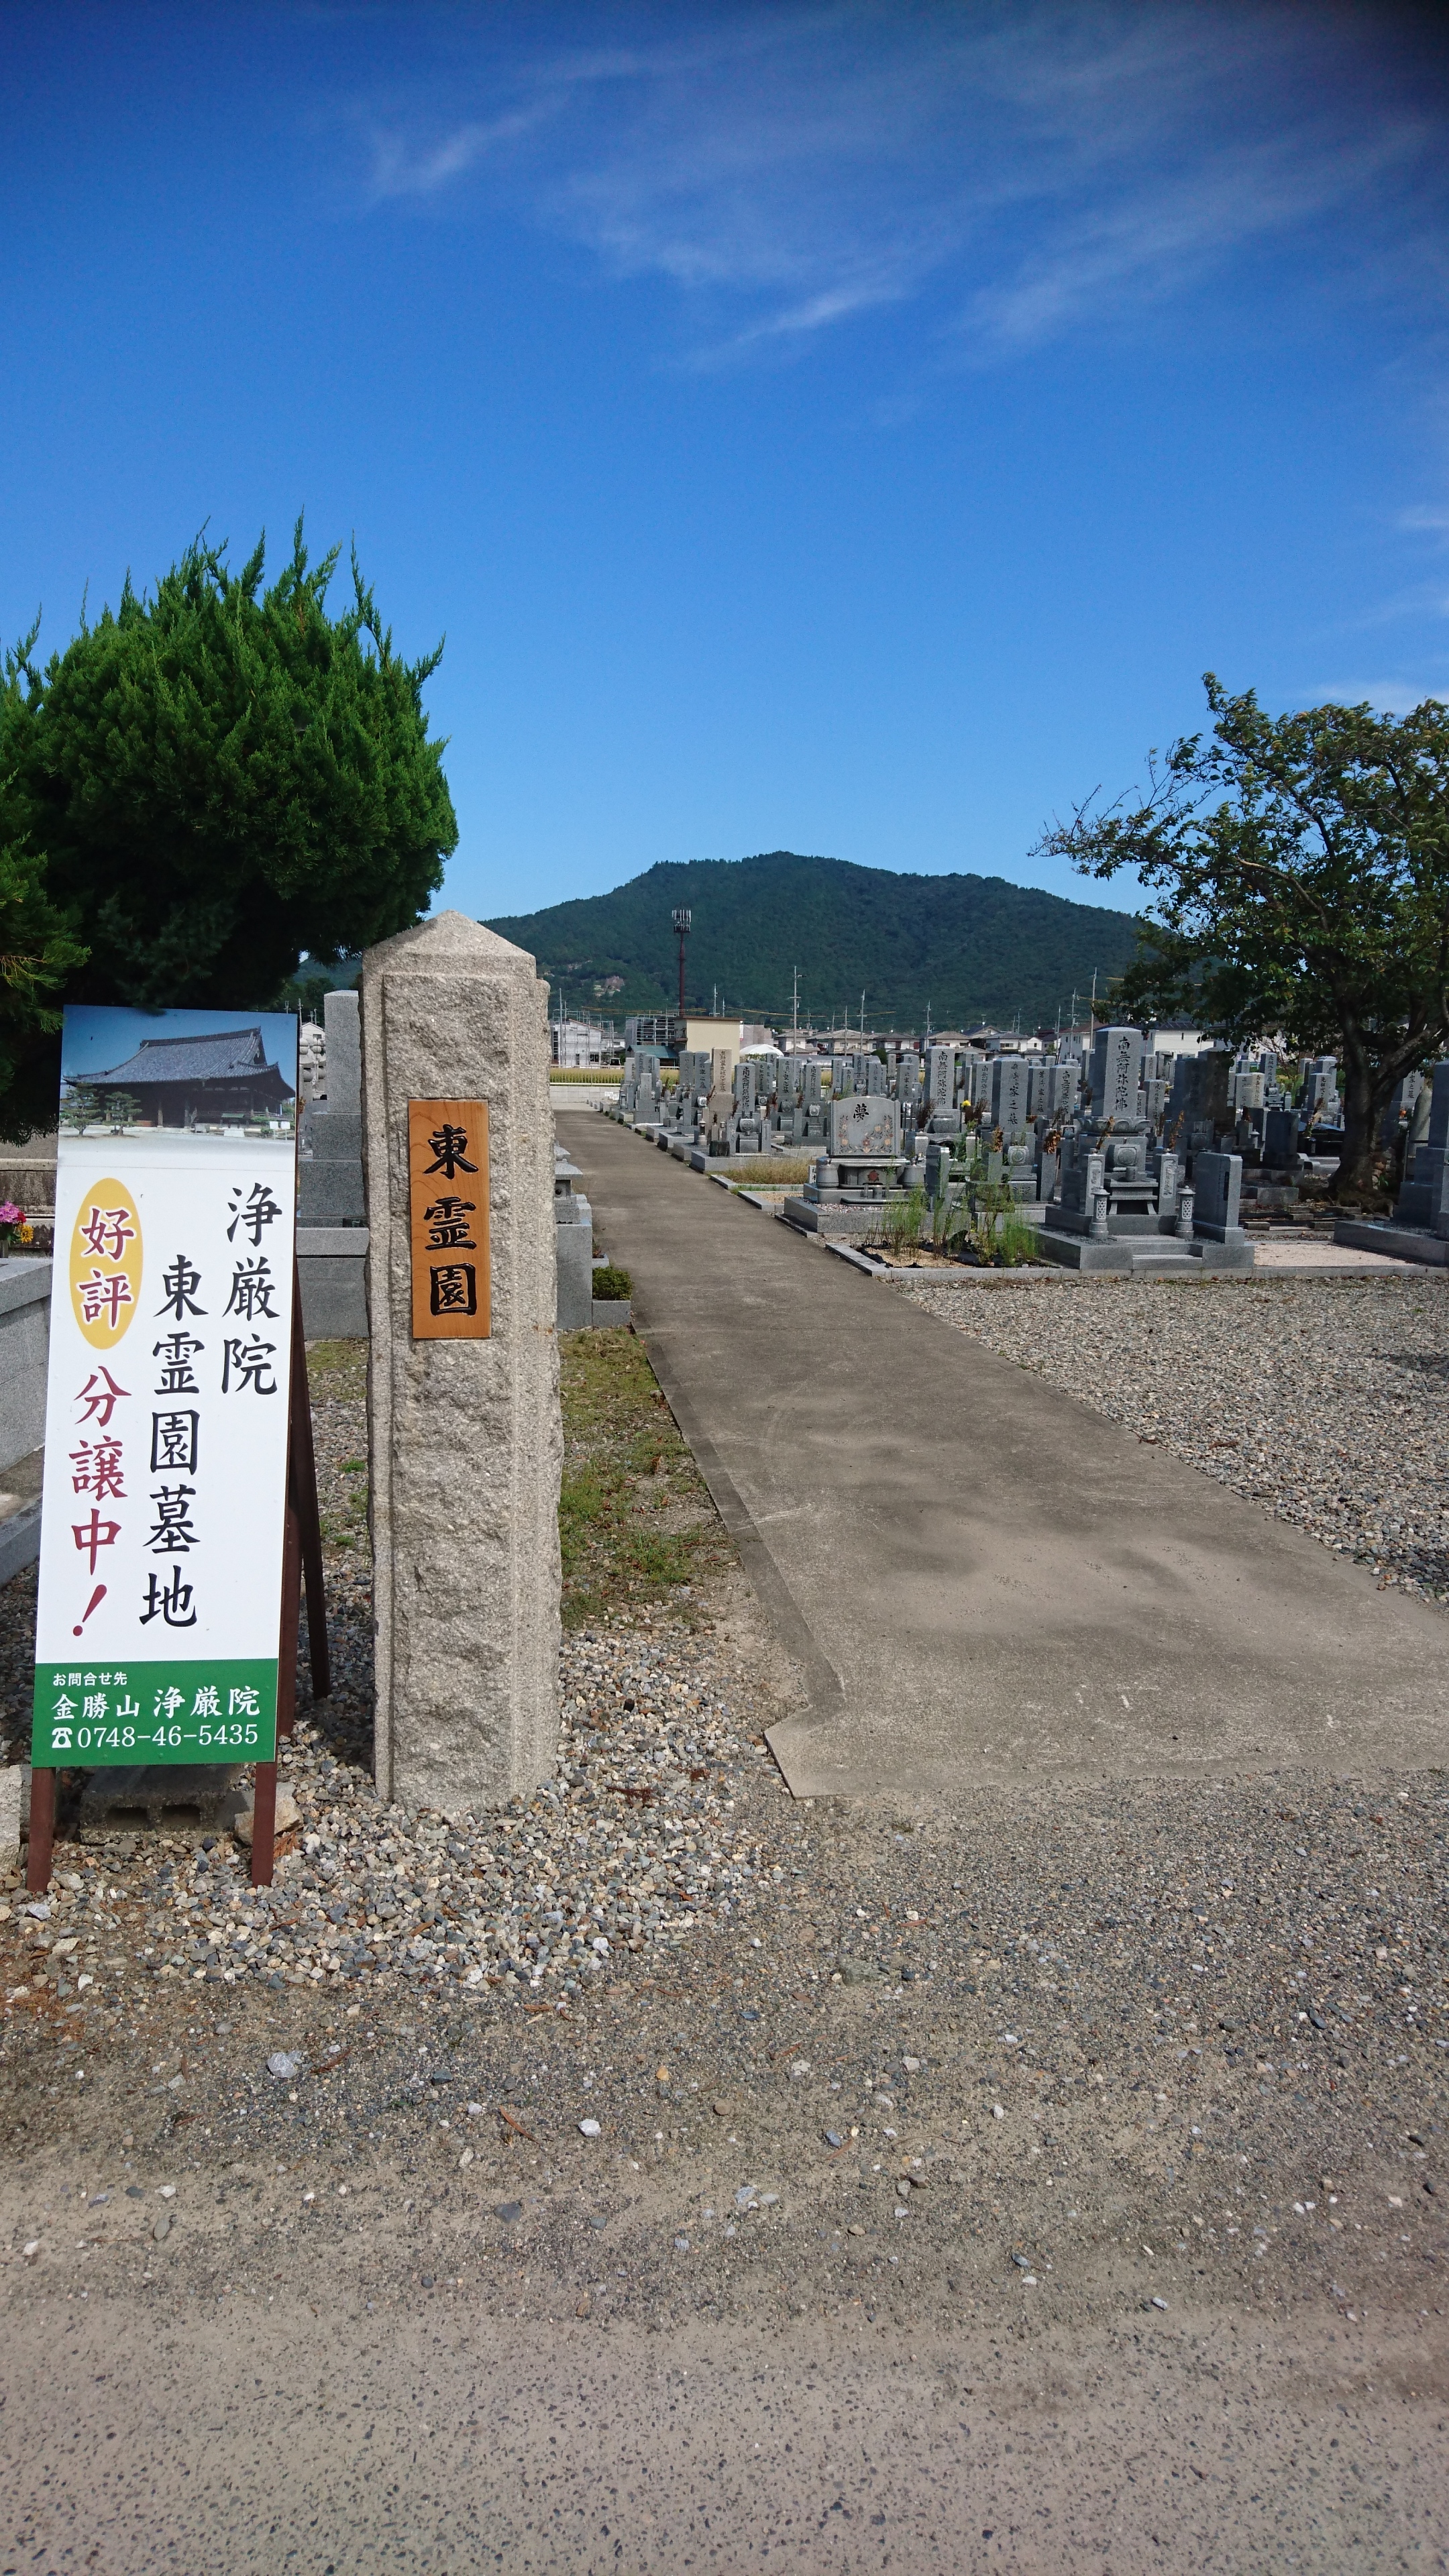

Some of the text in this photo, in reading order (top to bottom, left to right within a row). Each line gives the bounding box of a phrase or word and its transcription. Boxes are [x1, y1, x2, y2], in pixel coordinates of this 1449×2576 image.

[853, 1103, 869, 1123] 夢
[80, 1209, 135, 1326] 好評
[423, 1124, 479, 1317] 東霊園
[221, 1182, 282, 1395] 浄厳院
[139, 1254, 209, 1627] 東霊園墓地
[69, 1364, 132, 1637] 分譲中！
[52, 1685, 260, 1720] 金勝山 浄厳院
[53, 1672, 127, 1686] お問合せ先
[78, 1724, 258, 1748] 0748-46-5435
